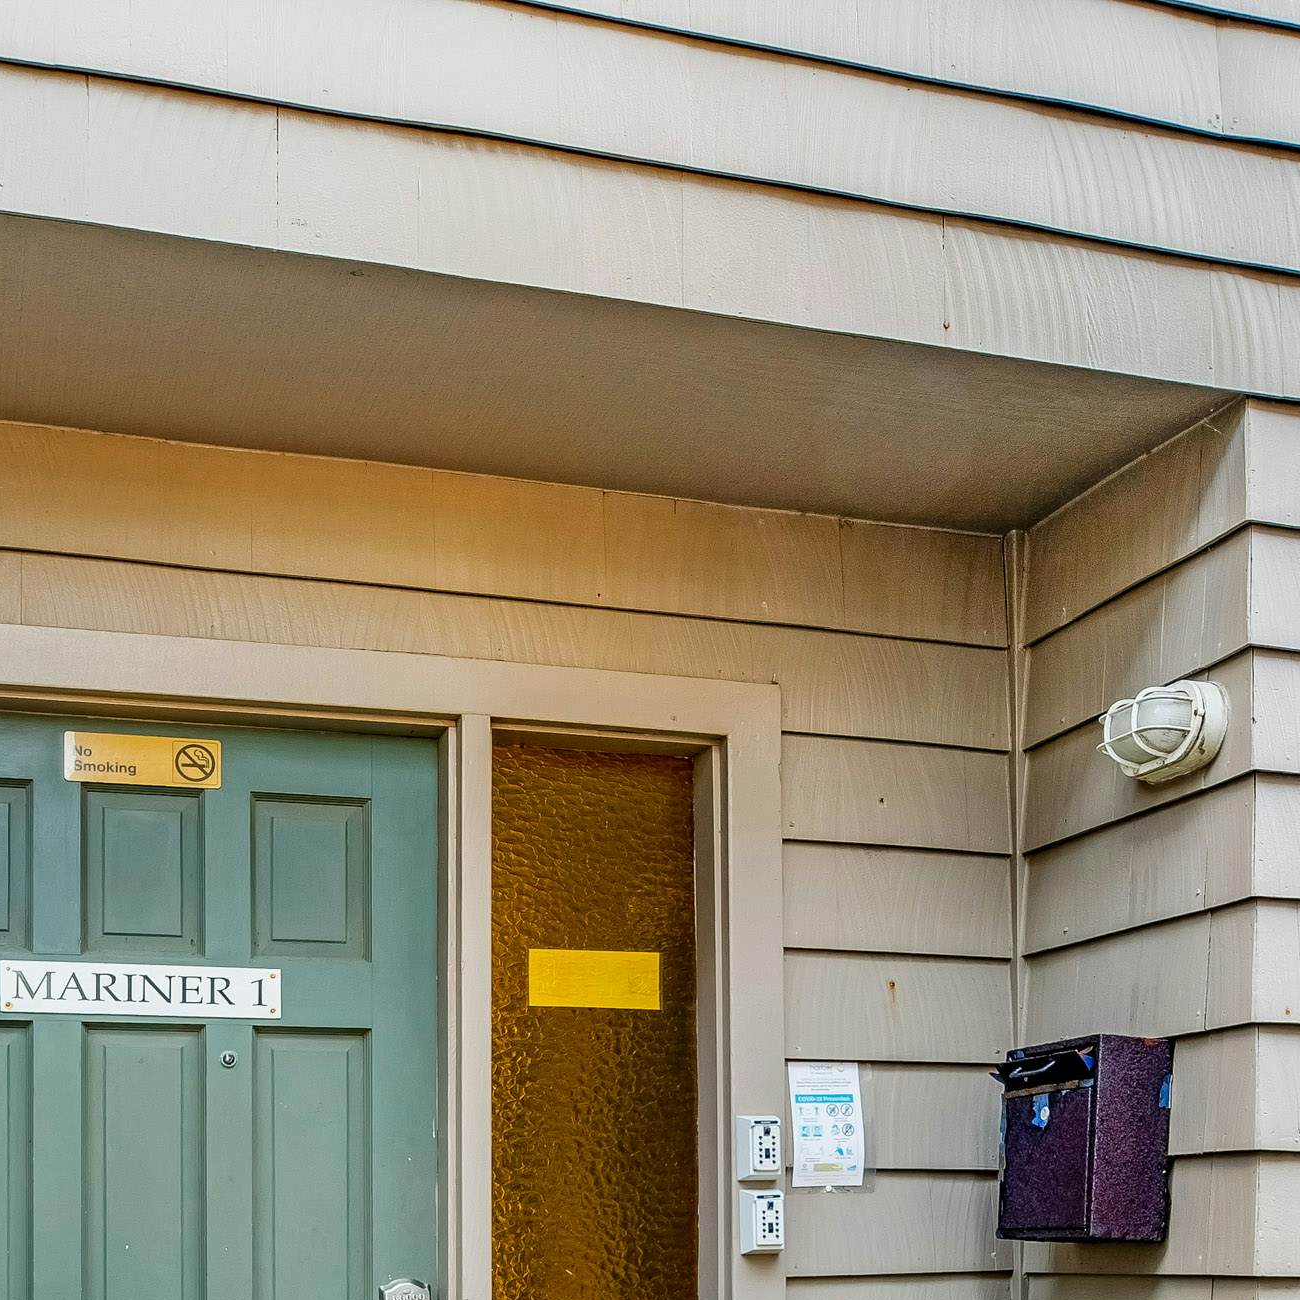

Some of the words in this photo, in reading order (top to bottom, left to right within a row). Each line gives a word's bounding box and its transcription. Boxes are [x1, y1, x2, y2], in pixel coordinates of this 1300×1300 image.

[74, 745, 92, 757] No
[74, 760, 136, 776] Smoking
[11, 970, 236, 1006] MARINER
[250, 978, 269, 1007] 1
